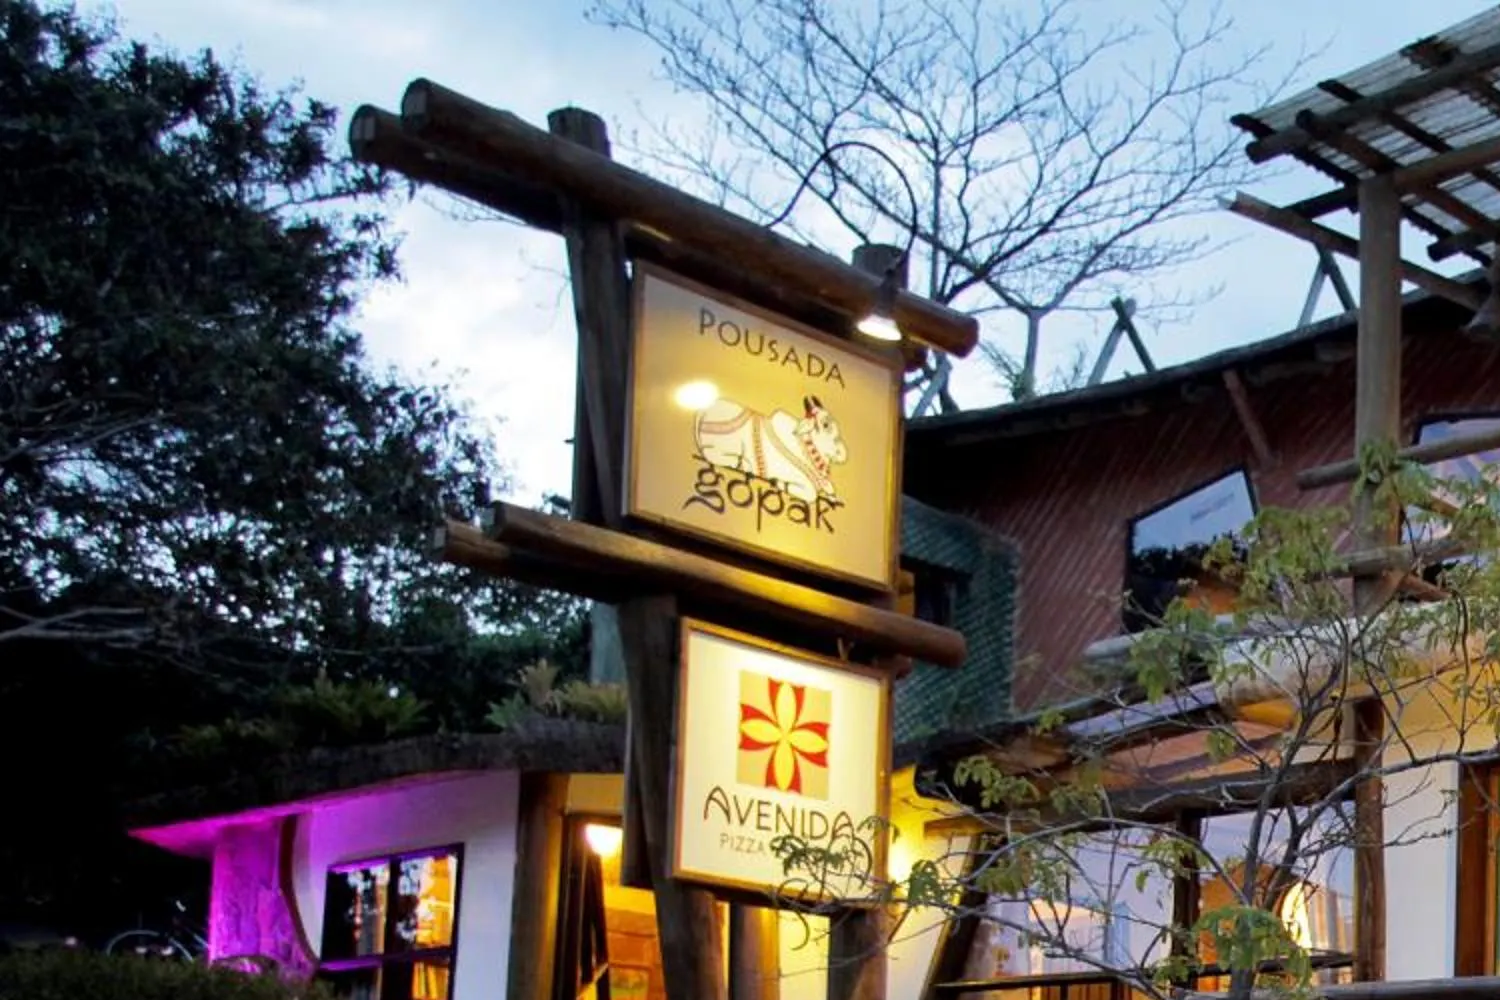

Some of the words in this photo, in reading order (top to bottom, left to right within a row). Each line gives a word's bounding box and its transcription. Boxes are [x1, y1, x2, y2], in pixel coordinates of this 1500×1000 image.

[699, 306, 846, 388] POUSADA
[682, 453, 845, 532] gopak
[703, 785, 854, 845] AVENIDA
